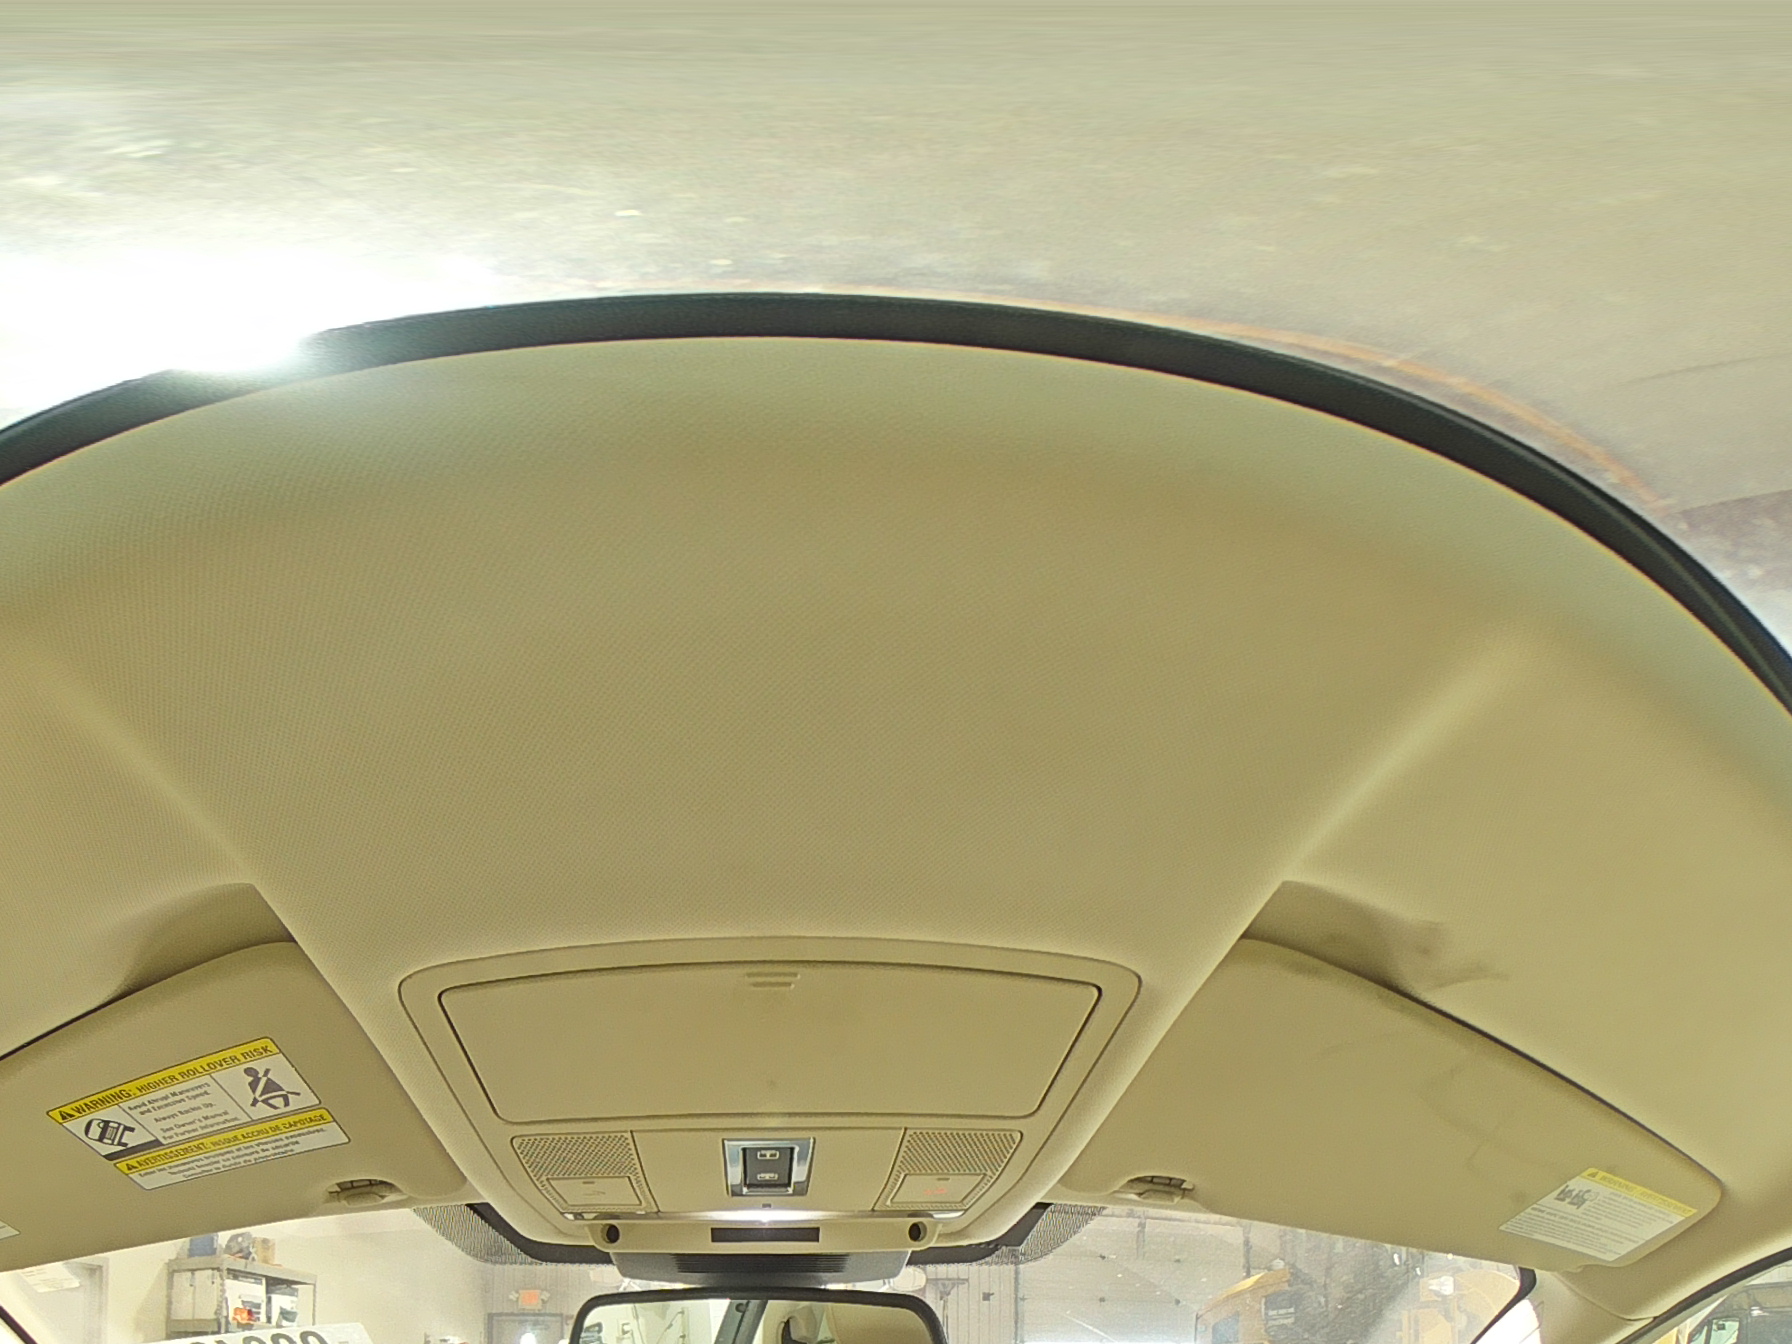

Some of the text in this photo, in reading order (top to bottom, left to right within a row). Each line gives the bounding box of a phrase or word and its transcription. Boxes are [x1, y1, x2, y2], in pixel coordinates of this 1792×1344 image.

[71, 1045, 273, 1116] WARNING: HIGHER ROLLOVER RISK
[271, 1124, 282, 1134] DE
